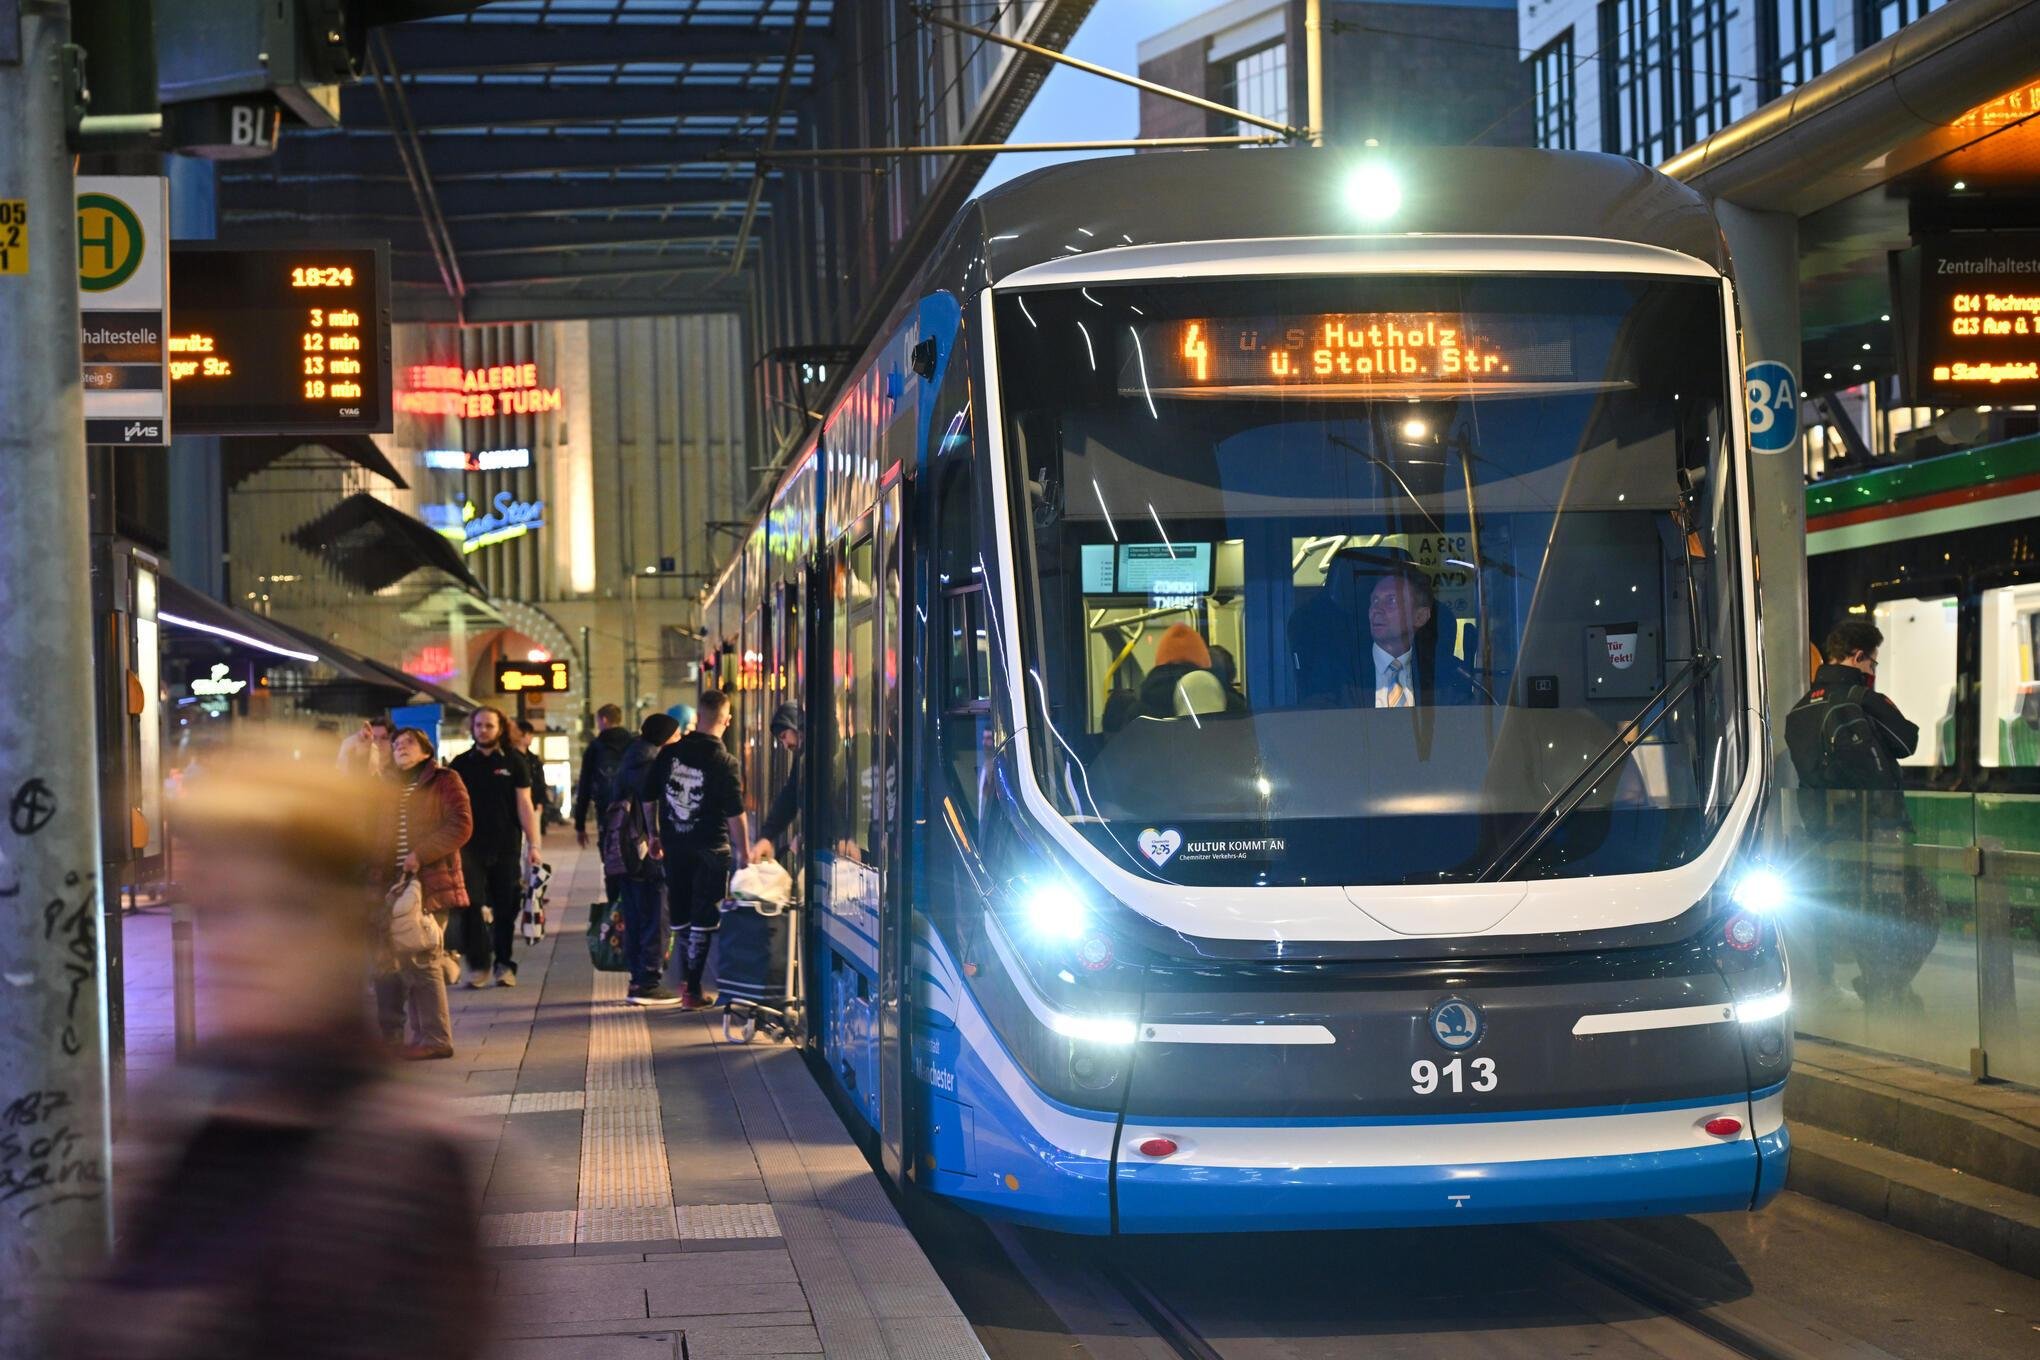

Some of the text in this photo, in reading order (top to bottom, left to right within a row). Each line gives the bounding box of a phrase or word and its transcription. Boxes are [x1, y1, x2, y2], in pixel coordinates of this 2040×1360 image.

[232, 106, 269, 146] BL
[292, 267, 354, 287] 18:24
[310, 309, 359, 327] 3 min
[304, 333, 324, 350] 12
[329, 333, 360, 350] min
[1184, 324, 1208, 380] 4
[1325, 322, 1456, 348] Hutholz
[304, 357, 324, 374] 13
[330, 357, 361, 374] min
[1271, 348, 1509, 375] ü. Stollb. Str.
[331, 380, 361, 398] min
[498, 387, 562, 415] TURM
[1187, 840, 1285, 852] KULTUR KOMMT AN
[1179, 852, 1247, 861] Chemnitzer Verkehrs-AG
[1410, 1057, 1498, 1095] 913
